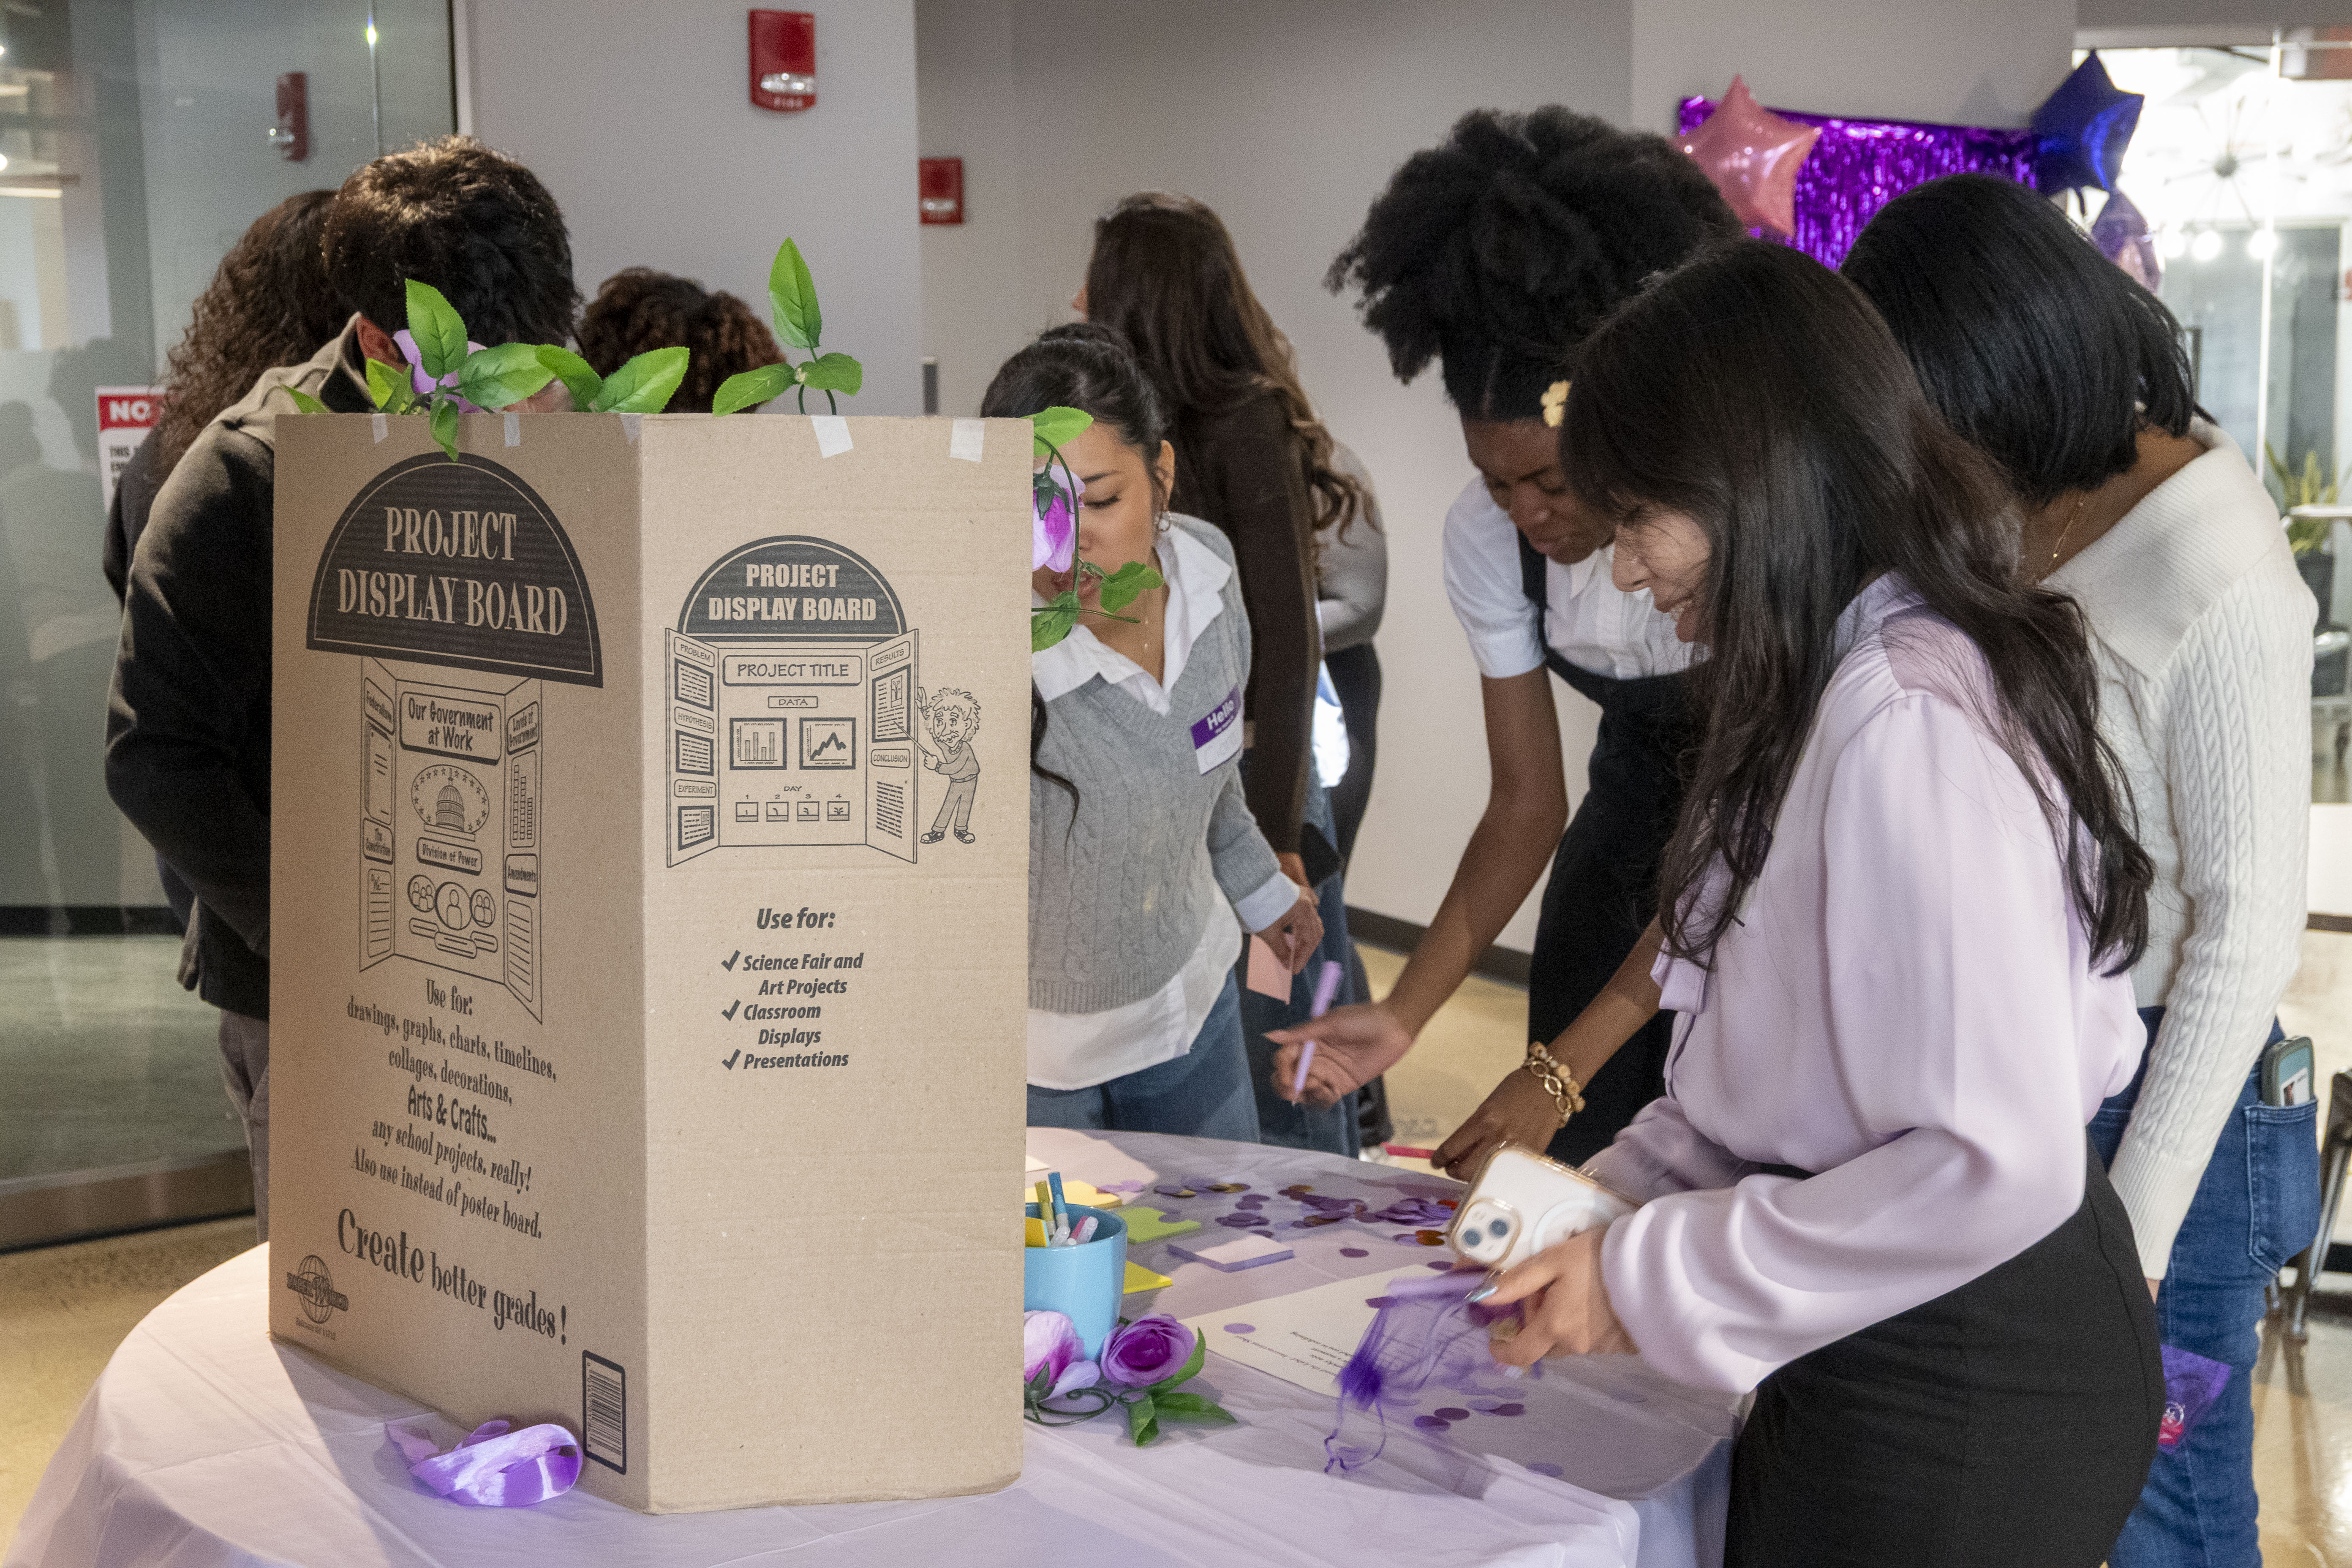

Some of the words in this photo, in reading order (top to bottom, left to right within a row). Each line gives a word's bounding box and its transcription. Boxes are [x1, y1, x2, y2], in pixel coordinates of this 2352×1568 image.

[384, 507, 517, 561] PROJECT
[746, 564, 839, 587] PROJECT
[338, 569, 459, 624] DISPLAY
[464, 580, 567, 636] BOARD
[709, 597, 798, 621] DISPLAY
[802, 597, 877, 621] BOARD
[680, 643, 711, 662] PROBLEM
[875, 648, 905, 666] RESULTS
[737, 664, 806, 677] PROJECT
[810, 664, 849, 677] TITLE
[778, 698, 808, 706] DATA
[408, 697, 426, 721] Our
[430, 700, 494, 732] Government
[678, 712, 712, 730] HYPOTHESIS
[1207, 700, 1234, 730] Hello
[427, 729, 439, 745] at
[443, 726, 473, 751] Work
[873, 754, 908, 763] CONCLUSION
[678, 785, 714, 795] EXPERIMENT
[422, 844, 447, 860] Division
[449, 851, 455, 862] of
[458, 852, 478, 867] Power
[757, 908, 793, 929] Use
[797, 907, 836, 928] for:
[743, 954, 798, 971] Science
[801, 953, 831, 969] Fair
[834, 952, 865, 969] and
[425, 978, 446, 1007] Use
[451, 985, 473, 1015] for:
[758, 980, 784, 996] Art
[787, 978, 847, 998] Projects
[743, 1004, 821, 1021] Classroom
[347, 995, 399, 1035] drawings,
[403, 1016, 446, 1045] graphs,
[450, 1025, 490, 1059] charts,
[494, 1041, 556, 1083] timelines,
[758, 1028, 821, 1048] Displays
[743, 1051, 849, 1070] Presentations
[389, 1046, 437, 1081] collages,
[441, 1059, 512, 1106] decorations,
[408, 1085, 432, 1122] Arts
[436, 1094, 446, 1126] &
[451, 1098, 496, 1144] Crafts...
[372, 1119, 393, 1146] any
[396, 1124, 433, 1155] school
[434, 1141, 487, 1175] projects,
[490, 1159, 531, 1194] really!
[351, 1147, 376, 1176] Also
[379, 1162, 398, 1183] use
[400, 1166, 443, 1202] instead
[446, 1181, 461, 1207] of
[460, 1197, 500, 1223] poster
[503, 1200, 542, 1239] board.
[338, 1209, 424, 1283] Create
[430, 1251, 487, 1309] better
